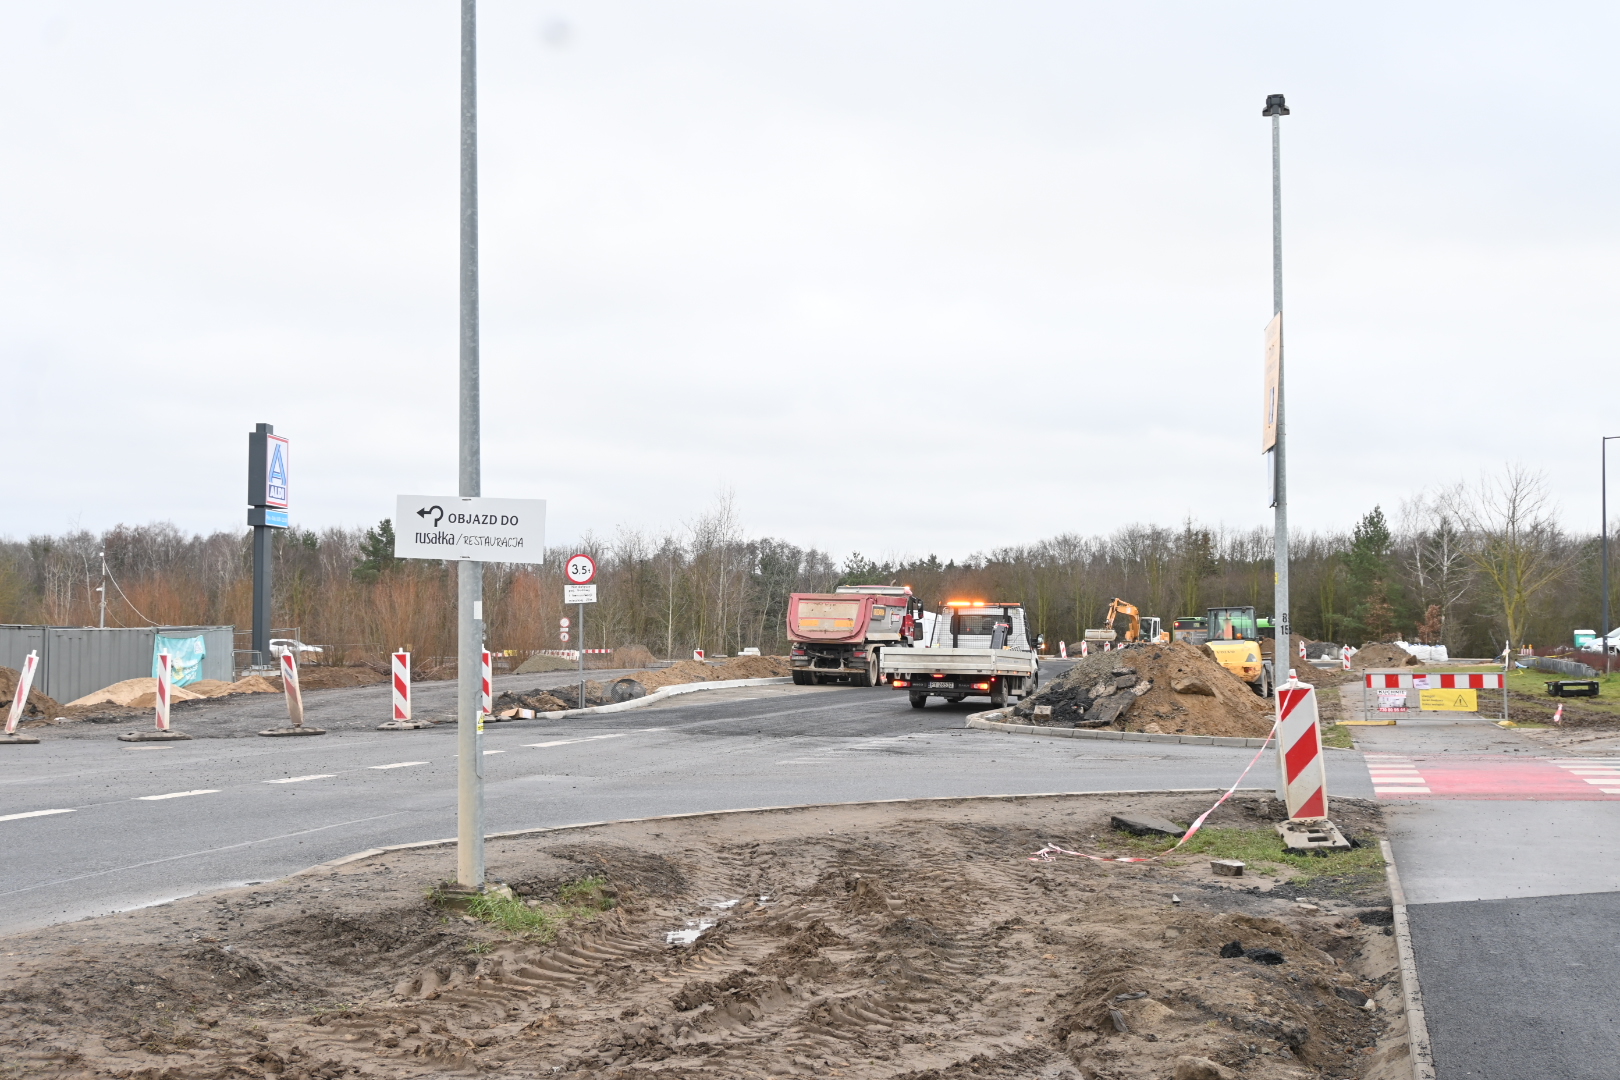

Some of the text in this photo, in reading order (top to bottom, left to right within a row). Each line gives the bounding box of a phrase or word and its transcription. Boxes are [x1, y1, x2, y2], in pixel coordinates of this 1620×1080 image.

[270, 485, 285, 500] ALDI
[448, 513, 519, 526] OBJAZD DO
